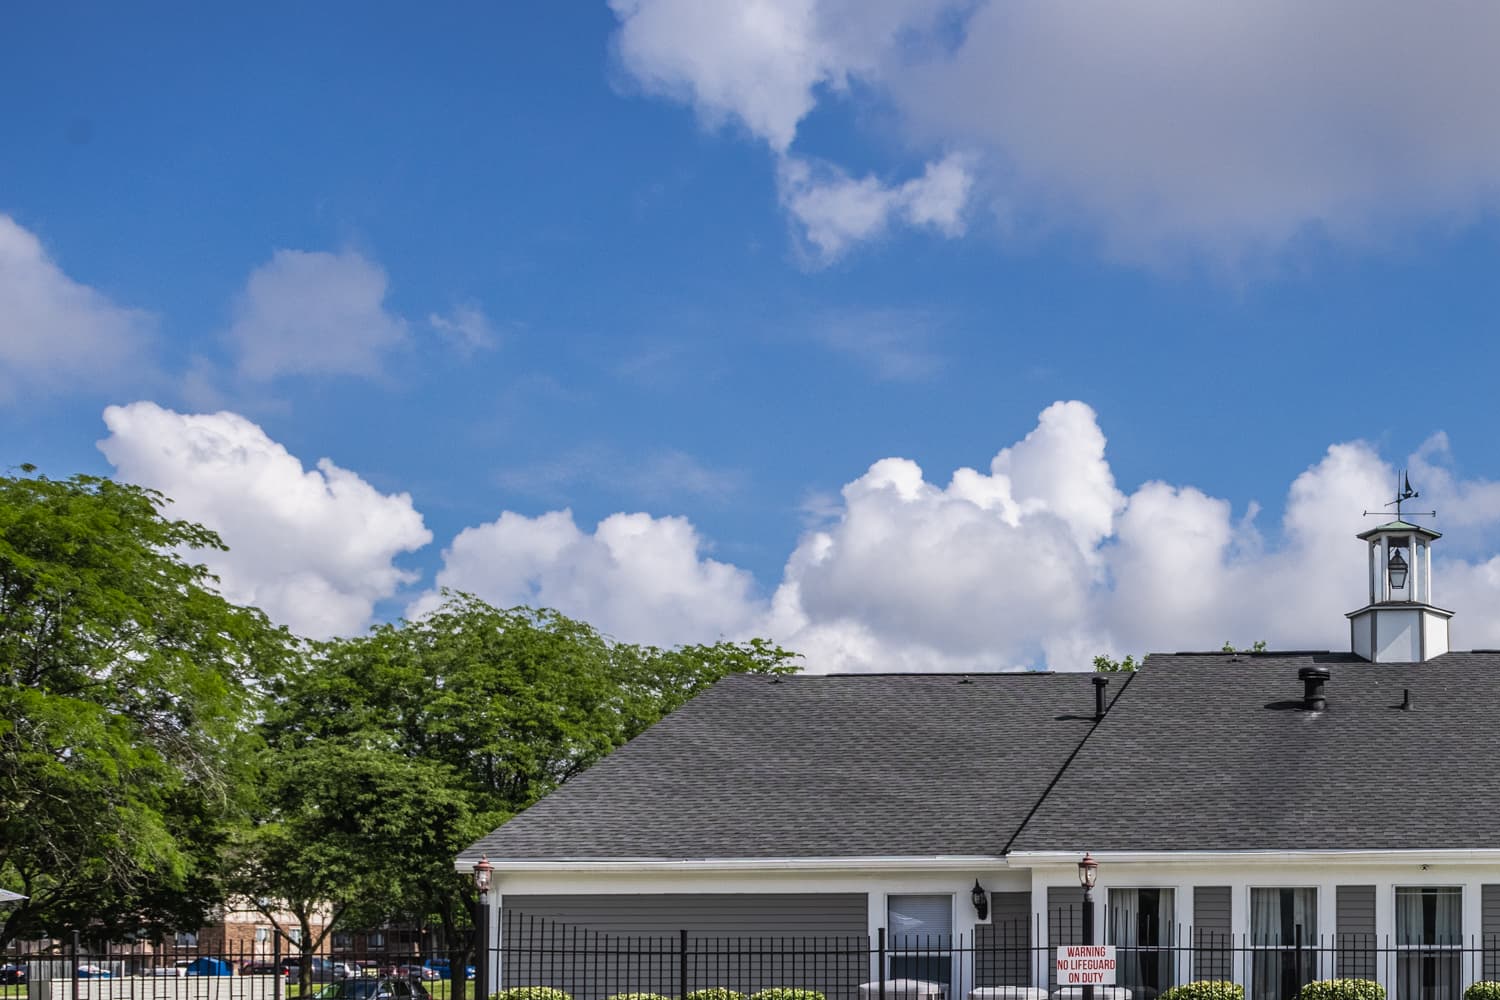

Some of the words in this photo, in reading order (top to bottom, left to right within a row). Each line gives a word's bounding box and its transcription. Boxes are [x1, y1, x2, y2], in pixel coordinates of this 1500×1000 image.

[1067, 946, 1106, 957] WARNING
[1057, 959, 1069, 970] NO
[1070, 959, 1116, 970] LIFEGUARD
[1068, 972, 1080, 983] ON
[1082, 972, 1104, 983] DUTY
